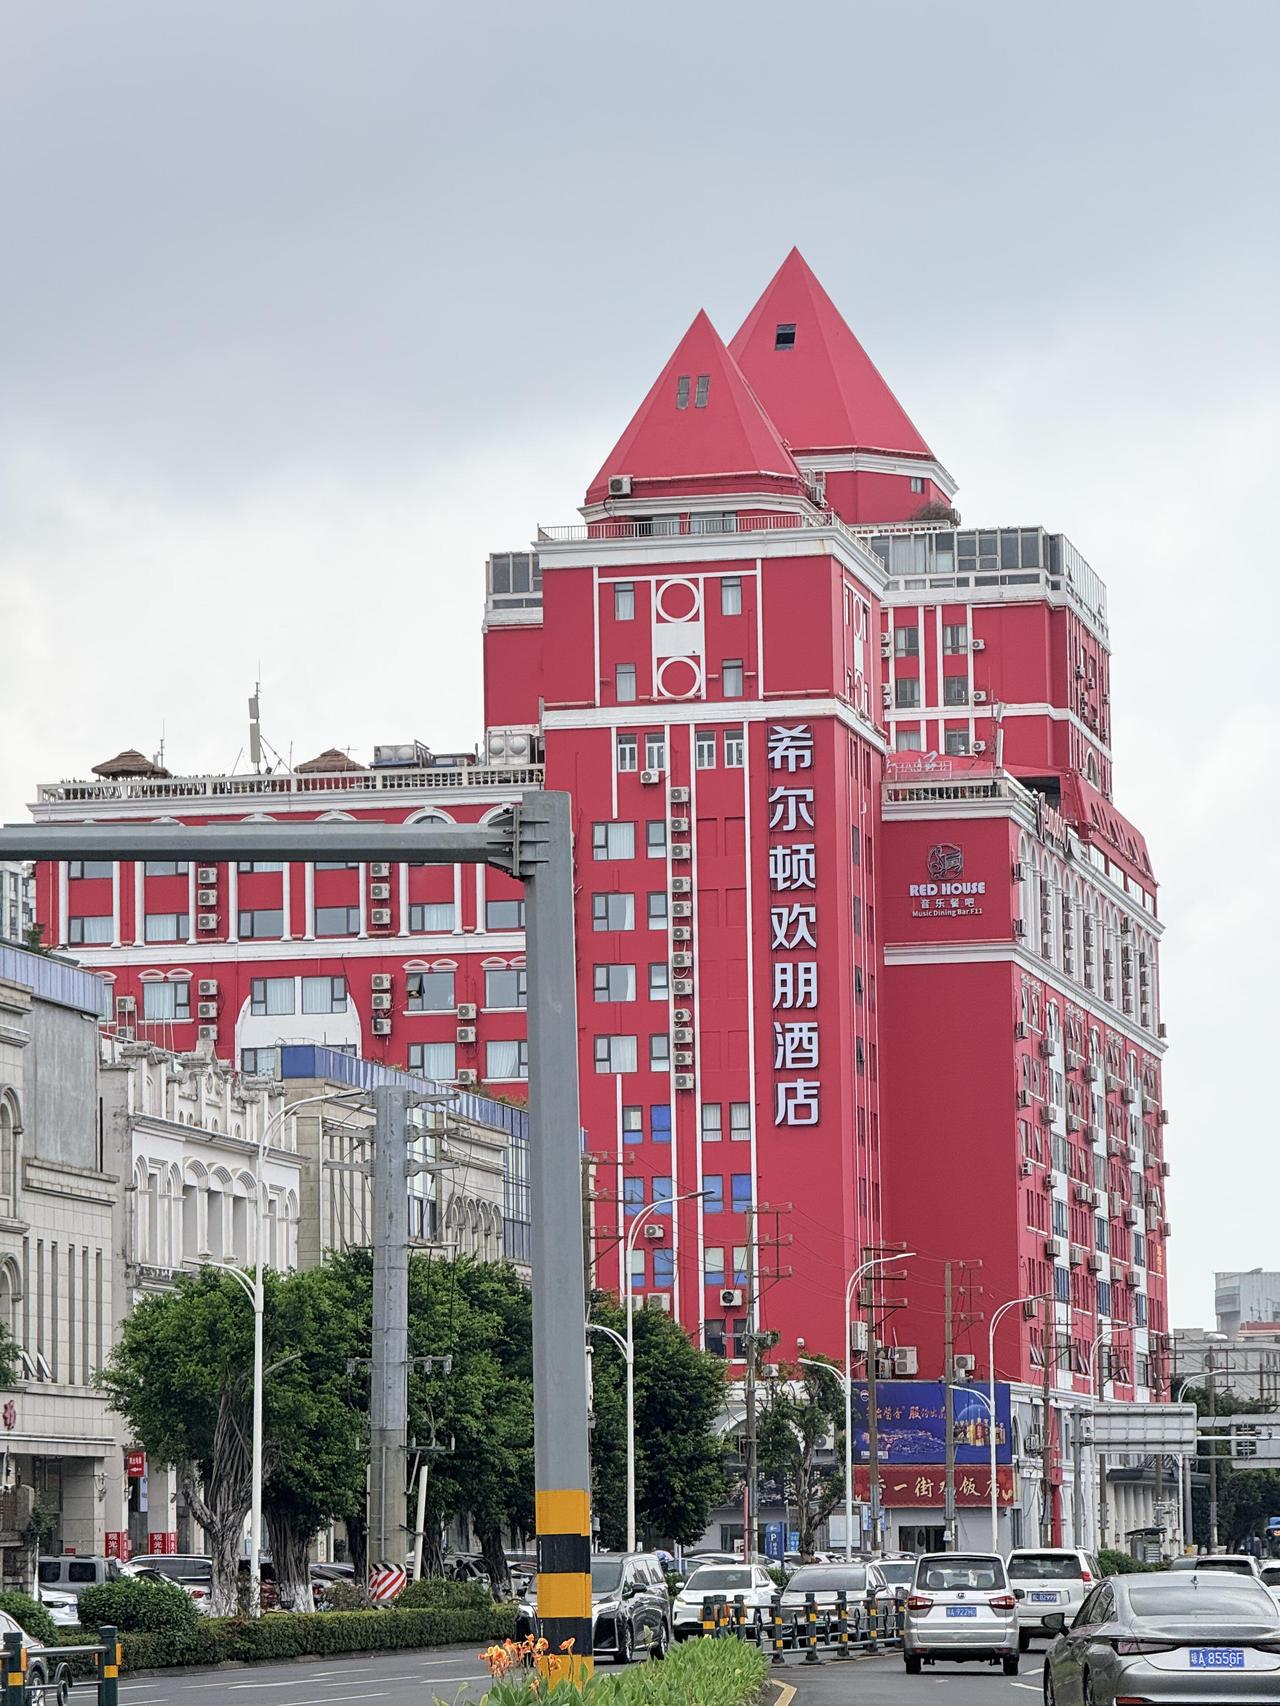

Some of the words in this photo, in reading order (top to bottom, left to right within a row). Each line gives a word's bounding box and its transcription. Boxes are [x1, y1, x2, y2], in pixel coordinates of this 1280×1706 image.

[909, 884, 938, 897] RED
[941, 882, 985, 895] HOUSE
[921, 898, 975, 909] 音乐餐吧
[768, 724, 820, 1127] 希尔顿欢朋酒店
[770, 1532, 778, 1543] P
